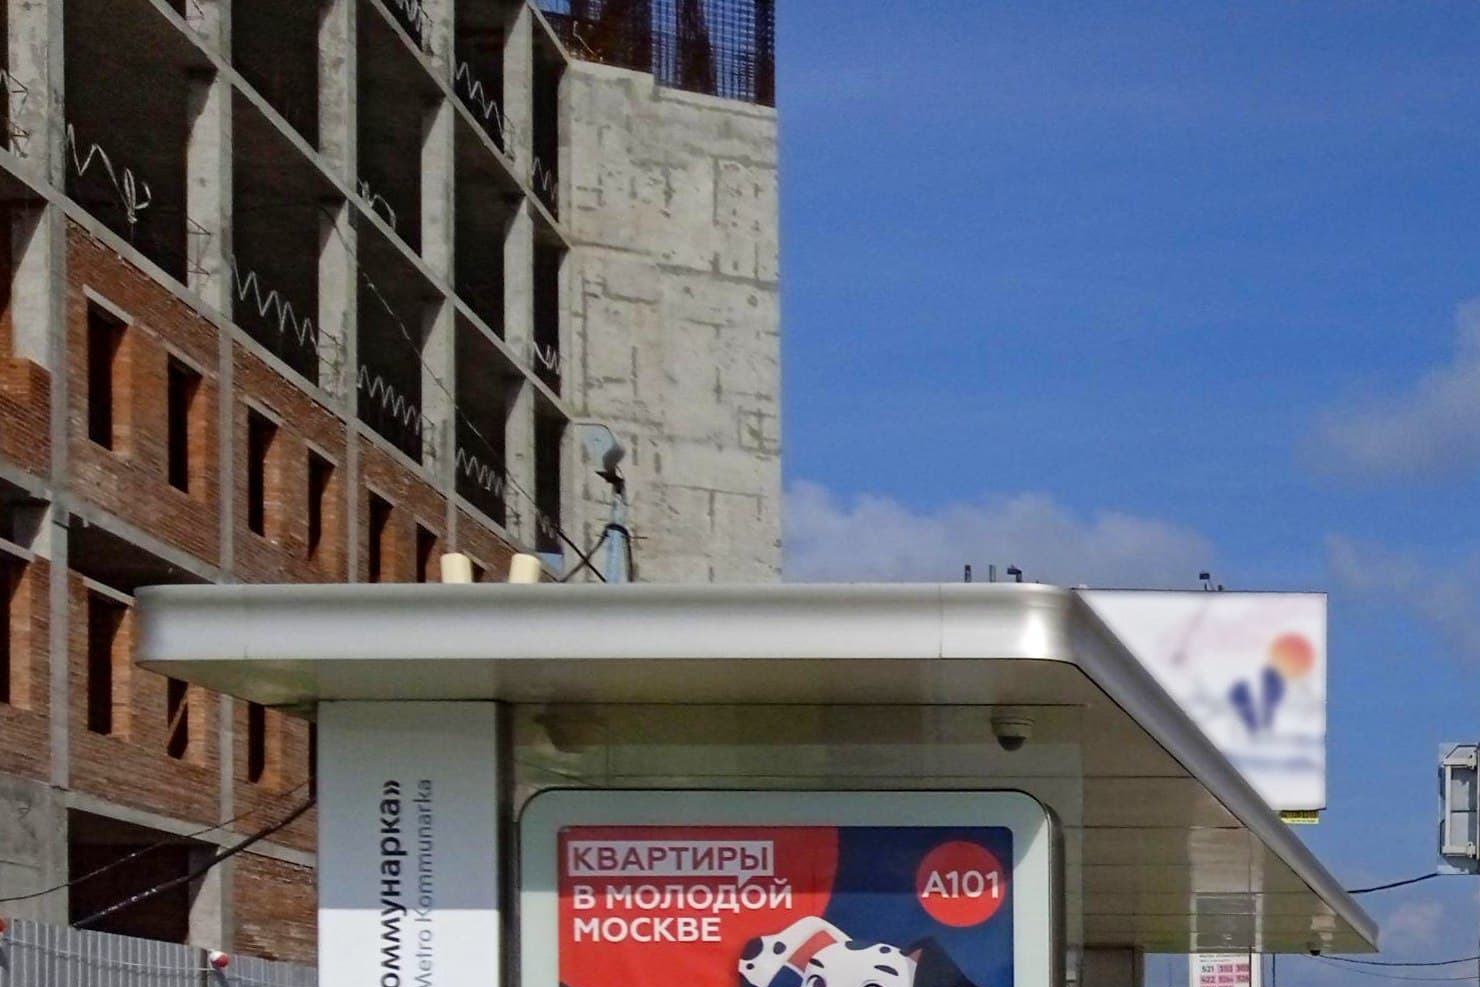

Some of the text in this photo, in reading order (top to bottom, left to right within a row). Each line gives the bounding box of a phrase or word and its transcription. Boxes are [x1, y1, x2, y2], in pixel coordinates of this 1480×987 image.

[411, 779, 434, 922] Kommunarka
[572, 846, 768, 872] КВАРТИРЫ
[573, 877, 793, 914] В МОЛОДОЙ
[573, 916, 722, 943] МОСКВЕ
